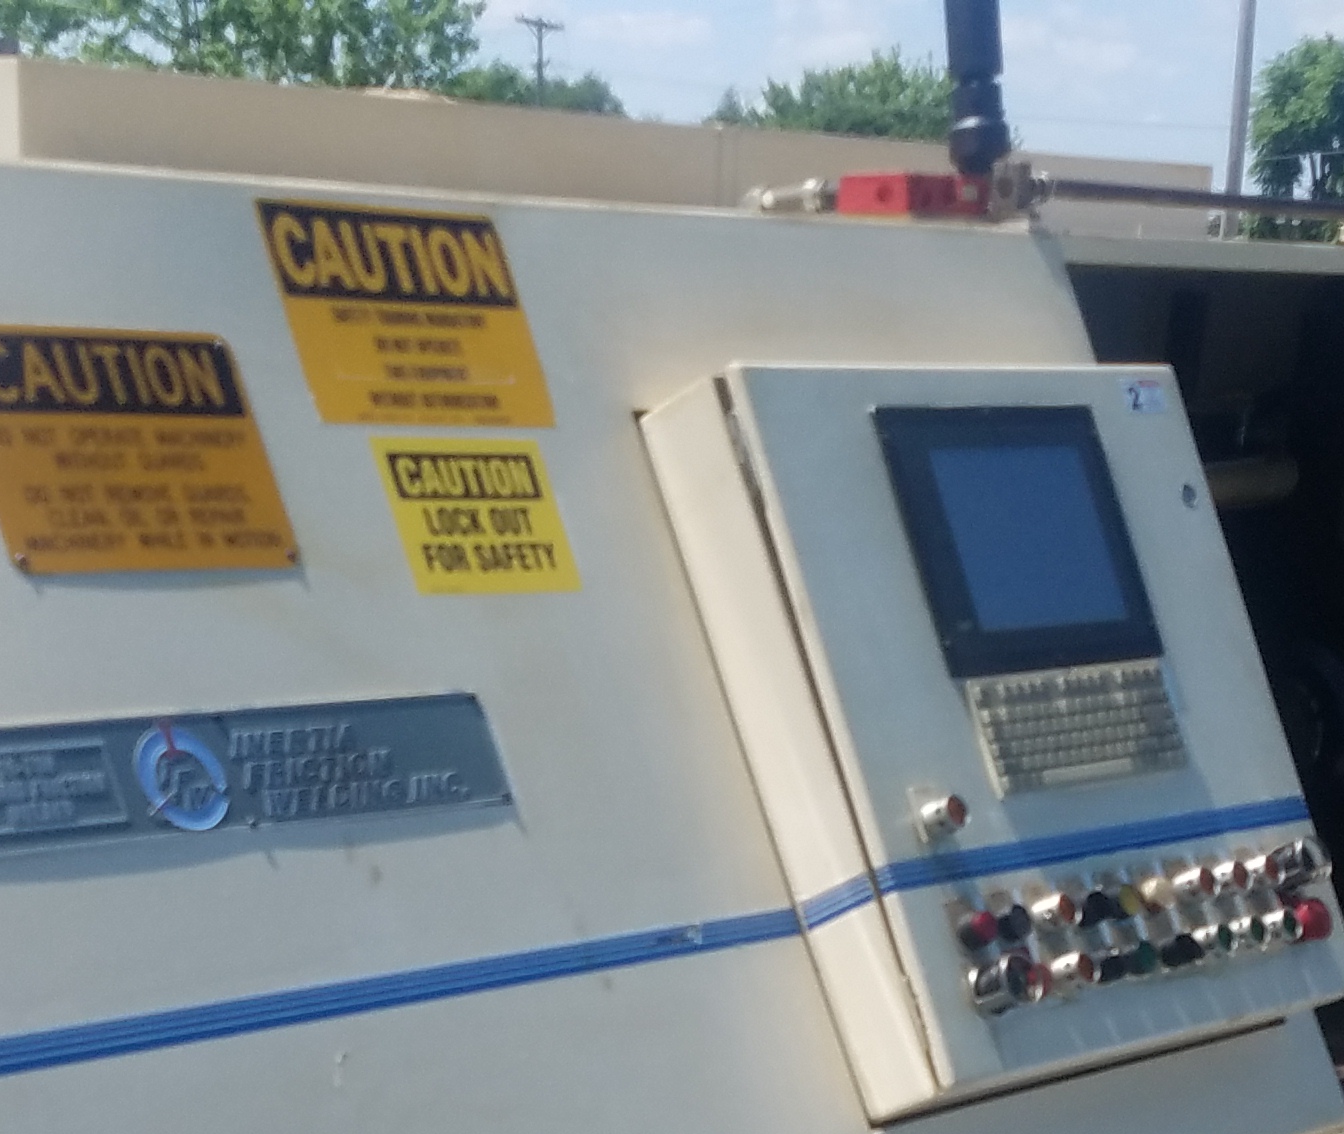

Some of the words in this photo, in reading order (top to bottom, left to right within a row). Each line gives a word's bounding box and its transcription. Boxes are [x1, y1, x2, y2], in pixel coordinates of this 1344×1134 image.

[272, 213, 509, 296] CAUTION
[395, 457, 536, 498] CAUTION
[423, 507, 485, 536] LOCK
[488, 507, 532, 536] OUT
[422, 543, 470, 571] FOR
[473, 543, 556, 572] SAFETY
